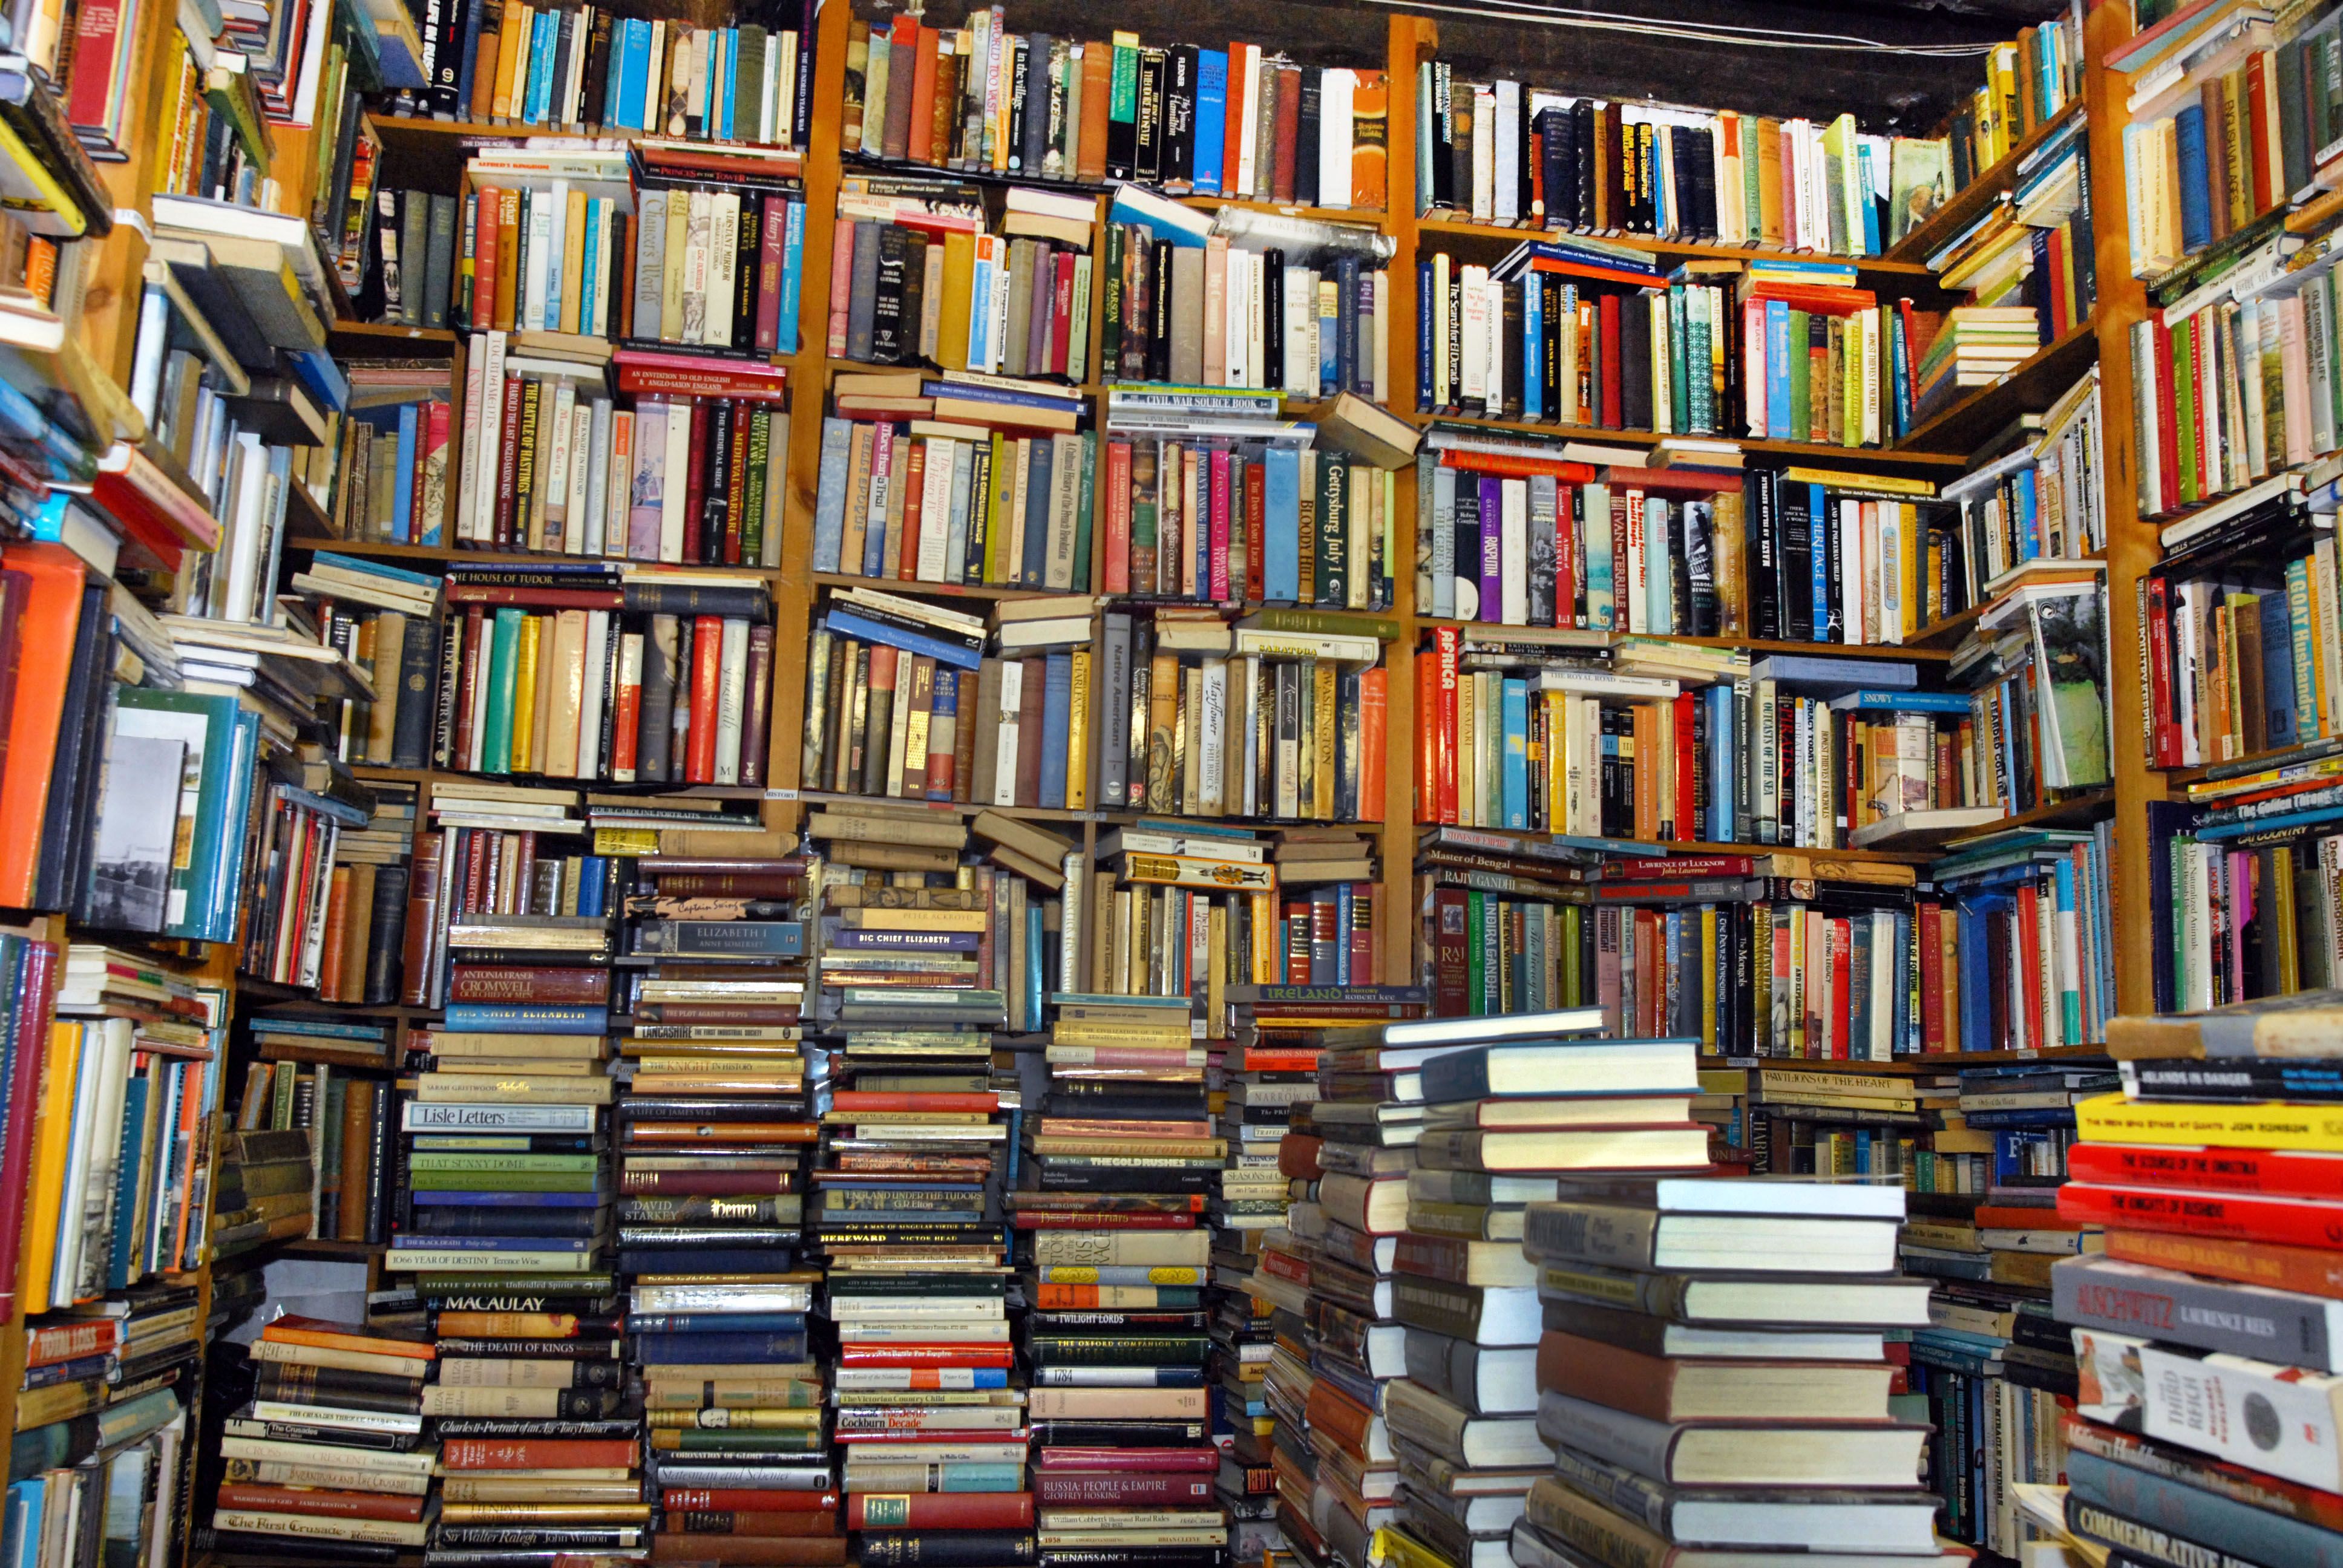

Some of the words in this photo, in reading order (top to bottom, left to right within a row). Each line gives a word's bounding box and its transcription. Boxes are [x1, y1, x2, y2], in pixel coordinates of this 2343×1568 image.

[1018, 52, 1027, 62] in
[1016, 64, 1027, 79] the
[1012, 80, 1026, 110] village
[667, 134, 686, 143] Society
[661, 168, 695, 177] PRINCES
[716, 172, 746, 182] TOWER
[766, 211, 782, 241] Henry
[770, 243, 780, 254] V
[2149, 270, 2172, 287] LORD
[2174, 256, 2201, 273] HOME
[1450, 283, 1459, 301] The
[1450, 301, 1459, 328] Search
[1450, 330, 1459, 342] for
[1450, 352, 1459, 385] Dorado
[648, 380, 691, 388] ANGLO-SAXON
[693, 382, 723, 391] ENGLAND
[704, 375, 731, 384] ENGLISH
[467, 369, 481, 430] KNIGHTS
[526, 384, 538, 401] THE
[1146, 394, 1171, 407] CIVIL
[1173, 395, 1193, 408] WAR
[1196, 396, 1230, 408] SOURCE
[1232, 397, 1257, 410] BOOK
[523, 403, 537, 435] BATTLE
[522, 437, 534, 449] OF
[732, 433, 743, 483] MEDIEVAL
[877, 454, 889, 475] than
[517, 450, 532, 493] HASTINGS
[875, 483, 886, 508] Trial
[1324, 465, 1344, 534] Gettysburg
[728, 486, 739, 534] WARFARE
[1613, 512, 1625, 542] IVAN
[1324, 536, 1344, 564] July
[1484, 536, 1498, 577] RASPUTIN
[1761, 540, 1771, 567] MALTA
[1813, 515, 1825, 580] HERITAGE
[453, 572, 465, 581] HE
[470, 573, 501, 583] HOUSE
[503, 574, 517, 583] OF
[520, 575, 553, 584] TUDOR
[1614, 553, 1626, 607] TERRIBLE
[2290, 579, 2309, 626] GOAT
[444, 635, 455, 675] TUDOR
[1113, 644, 1123, 684] Native
[1441, 630, 1455, 689] AFRICA
[2294, 629, 2315, 724] Husbandry
[1205, 676, 1223, 736] Mayflower
[1864, 694, 1893, 704] SNOWY
[437, 679, 452, 743] PORTRAITS
[1112, 687, 1122, 748] Americans
[1763, 702, 1773, 744] OUTCASTS
[1990, 701, 2000, 750] BEARDED
[1763, 746, 1773, 757] OF
[1206, 743, 1214, 791] PHILBRICK
[1763, 760, 1773, 777] THE
[1994, 753, 2005, 799] COLLIES
[1763, 780, 1772, 795] SEA
[1432, 850, 1463, 862] Master
[1464, 854, 1475, 863] of
[1477, 855, 1511, 871] Bengal
[2329, 841, 2339, 871] Deer
[1445, 871, 1475, 884] RAJIV
[1477, 875, 1516, 890] GANDHI
[1661, 867, 1676, 876] John
[1486, 903, 1496, 946] INDIRA
[2332, 876, 2343, 961] Management
[697, 927, 758, 938] ELIZABETH
[763, 927, 767, 938] I
[905, 935, 950, 944] ELIZABETH
[724, 940, 763, 949] SOMERSET
[1442, 946, 1464, 962] RAJ
[504, 972, 535, 980] FRASER
[1486, 948, 1497, 998] GANDHI
[1737, 950, 1748, 987] Mongols
[460, 980, 532, 992] CROMWELL
[643, 1026, 692, 1038] LANCASHIRE
[1248, 1048, 1293, 1057] GEORGIAN
[1255, 1093, 1302, 1102] NARROW
[424, 1108, 455, 1124] Lisle
[459, 1109, 505, 1125] Letters
[1090, 1157, 1112, 1166] THE
[393, 1255, 412, 1265] 1066
[414, 1255, 437, 1265] YEAR
[439, 1256, 448, 1265] OF
[452, 1256, 488, 1266] DESTINY
[493, 1256, 520, 1266] Terence
[521, 1257, 540, 1266] Wise
[446, 1296, 545, 1312] MACAULAY
[2077, 1284, 2175, 1329] AUSCHWITZ
[1060, 1315, 1096, 1324] TWILIGHT
[1099, 1315, 1124, 1324] LORDS
[1054, 1369, 1072, 1382] 1784
[2164, 1370, 2185, 1426] THIRD
[2184, 1376, 2204, 1432] REICH
[1044, 1481, 1080, 1492] RUSSIA:
[1083, 1481, 1118, 1491] PEOPLE
[1122, 1481, 1129, 1491] &
[1131, 1480, 1167, 1491] EMPIRE
[1044, 1492, 1082, 1500] GEOFFREY
[1084, 1491, 1120, 1500] HOSKING
[228, 1515, 252, 1528] The
[257, 1517, 287, 1530] First
[289, 1520, 342, 1535] Crusade
[444, 1529, 459, 1543] Sir
[461, 1529, 496, 1543] Walter
[499, 1529, 537, 1544] Ralegh
[545, 1532, 569, 1544] John
[571, 1532, 607, 1544] Winton
[1054, 1553, 1129, 1563] RENAISSANCE
